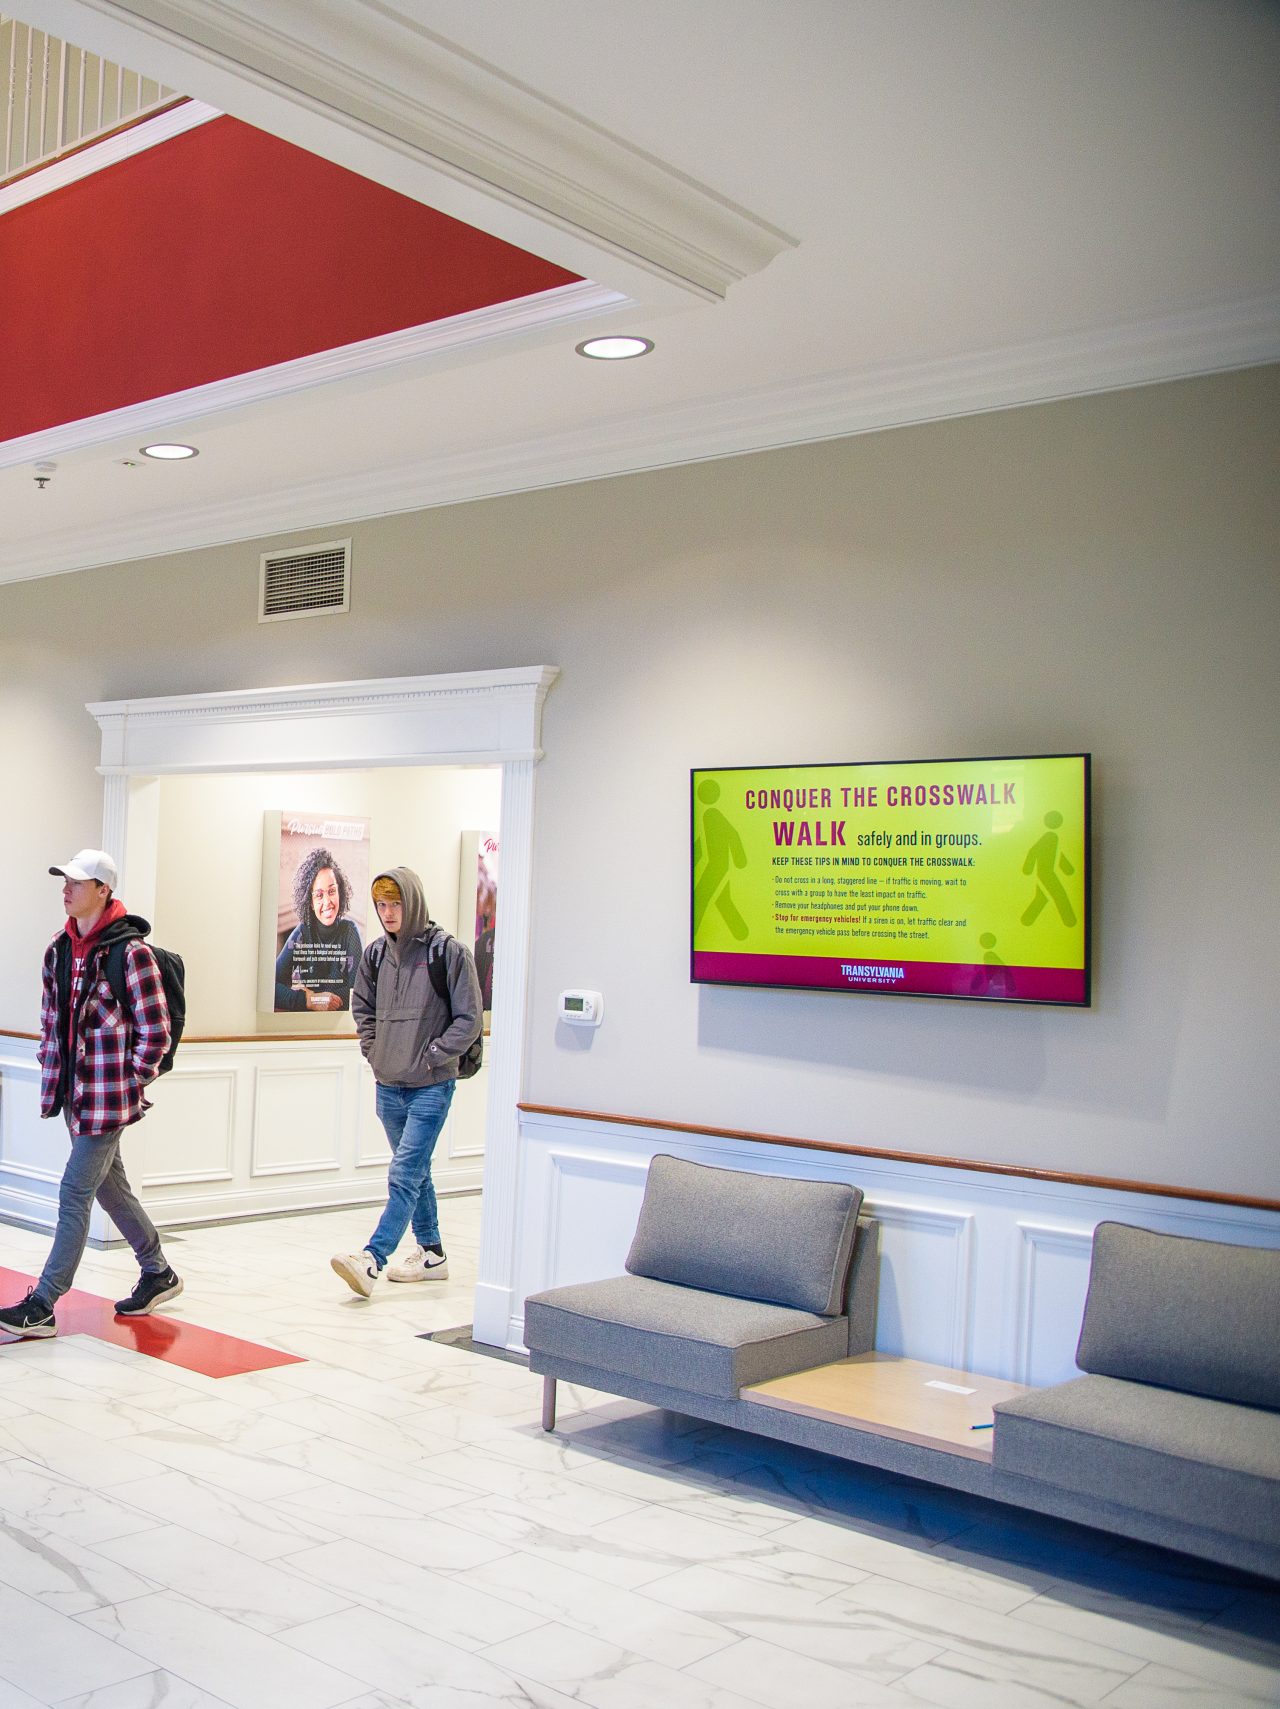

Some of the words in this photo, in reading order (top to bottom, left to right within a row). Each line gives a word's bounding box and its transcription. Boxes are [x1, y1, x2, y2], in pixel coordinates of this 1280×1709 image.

[746, 788, 832, 812] CONQUER
[840, 787, 877, 807] THE
[887, 783, 1016, 806] CROSSWALK
[773, 821, 846, 846] WALK
[857, 831, 892, 848] safely
[896, 831, 917, 846] and
[921, 831, 931, 846] in
[935, 833, 982, 848] groups.
[772, 857, 788, 866] KEEP
[791, 857, 812, 866] THESE
[815, 857, 830, 866] TIPS
[832, 857, 839, 866] IN
[842, 857, 860, 866] MIND
[862, 858, 871, 866] TO
[873, 858, 907, 867] CONQUER
[910, 858, 924, 866] THE
[926, 858, 975, 866] CROSSWALK:
[822, 877, 835, 885] long,
[838, 877, 865, 885] staggered
[892, 877, 911, 885] traffic
[920, 878, 943, 886] moving,
[945, 878, 958, 886] wait
[876, 891, 896, 899] impact
[810, 902, 843, 910] headphones
[882, 904, 900, 912] phone
[901, 904, 919, 912] down.
[907, 917, 915, 925] let
[917, 918, 936, 926] traffic
[938, 918, 953, 926] clear
[786, 928, 814, 936] emergency
[872, 930, 896, 938] crossing
[898, 930, 907, 938] the
[909, 931, 930, 939] street.
[841, 964, 904, 978] TRANSYLVANIA
[848, 976, 896, 984] UNIVERSITY
